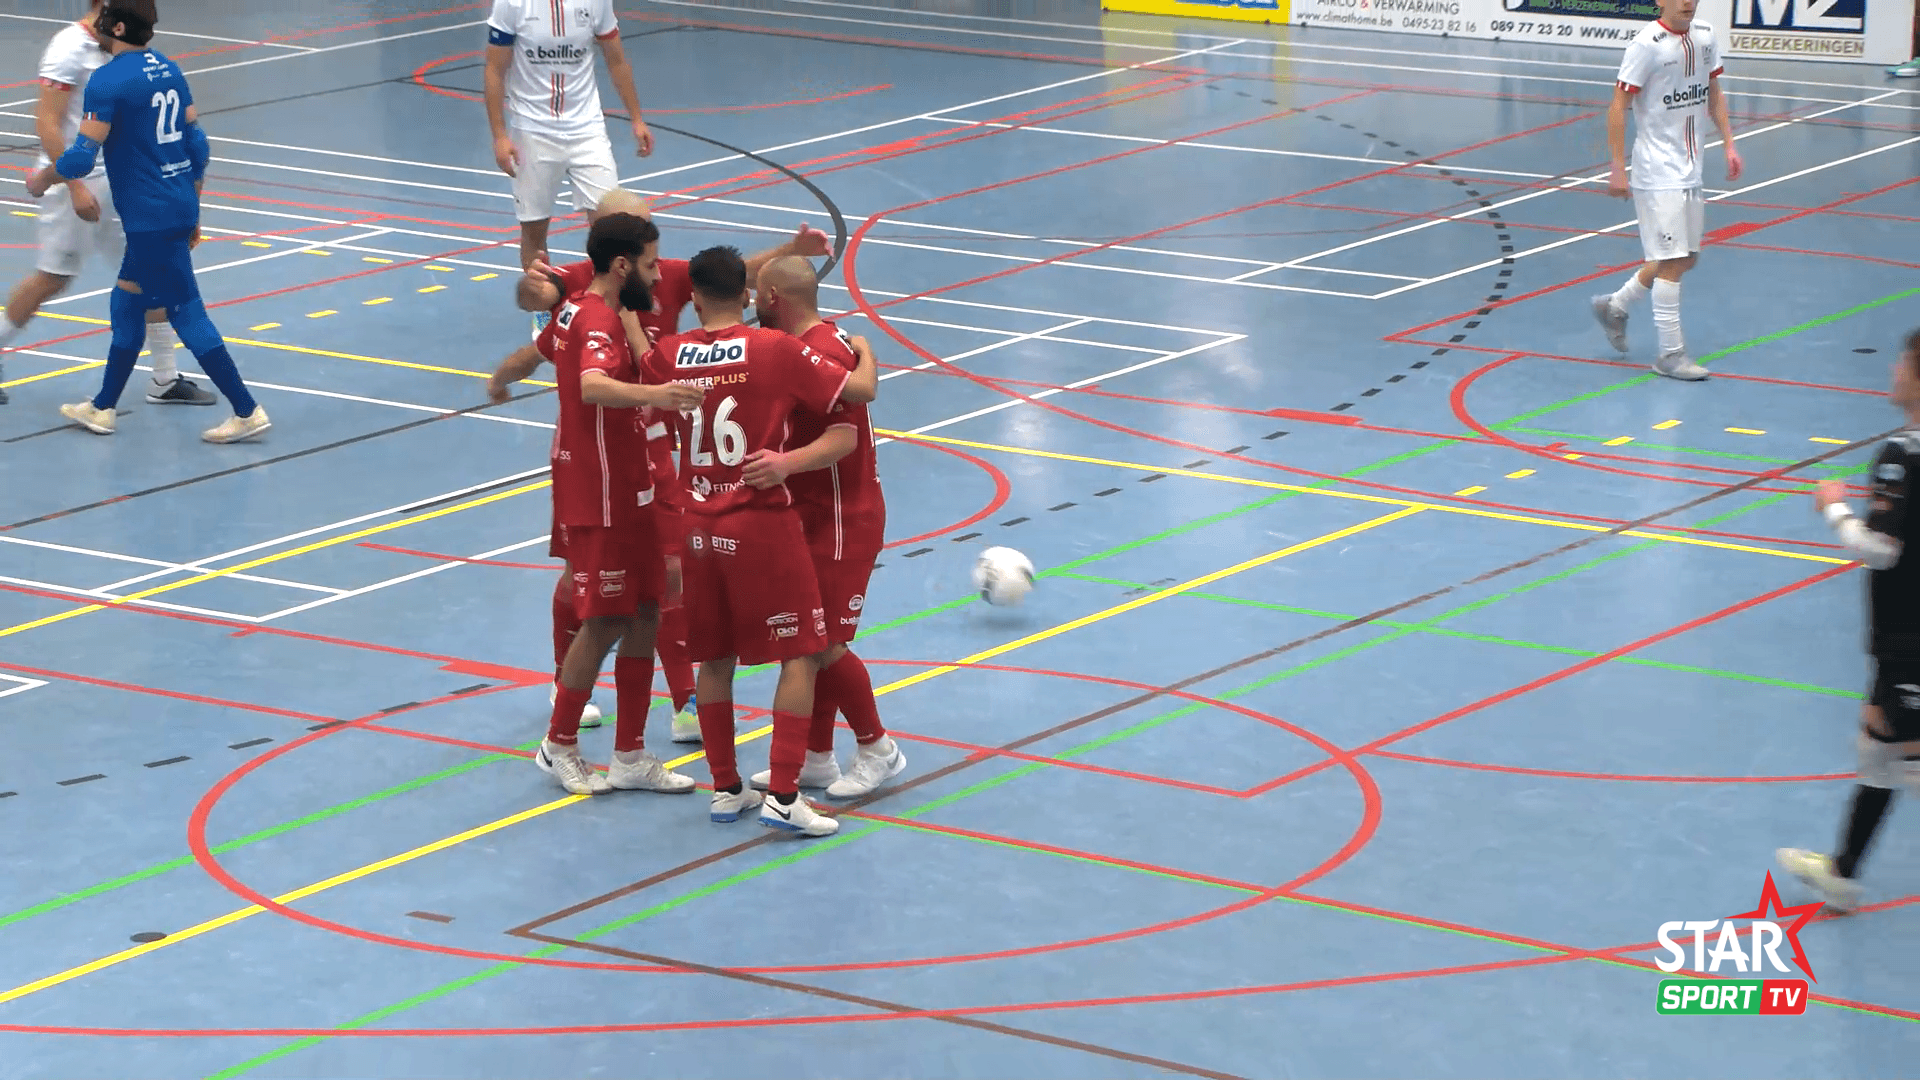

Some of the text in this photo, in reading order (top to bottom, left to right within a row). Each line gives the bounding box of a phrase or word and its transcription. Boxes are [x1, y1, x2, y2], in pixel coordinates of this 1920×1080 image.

[1374, 0, 1460, 15] VERWARMING
[1297, 11, 1393, 27] www.climathome.be
[1449, 19, 1461, 32] 82
[1465, 21, 1477, 33] 16
[1490, 20, 1636, 41] 089 77 23 20 WWW.JE
[1730, 35, 1865, 54] VERZEKERINGEN
[152, 89, 182, 144] 22
[677, 344, 743, 366] Hubo
[679, 395, 747, 467] 26
[711, 535, 737, 551] BITS
